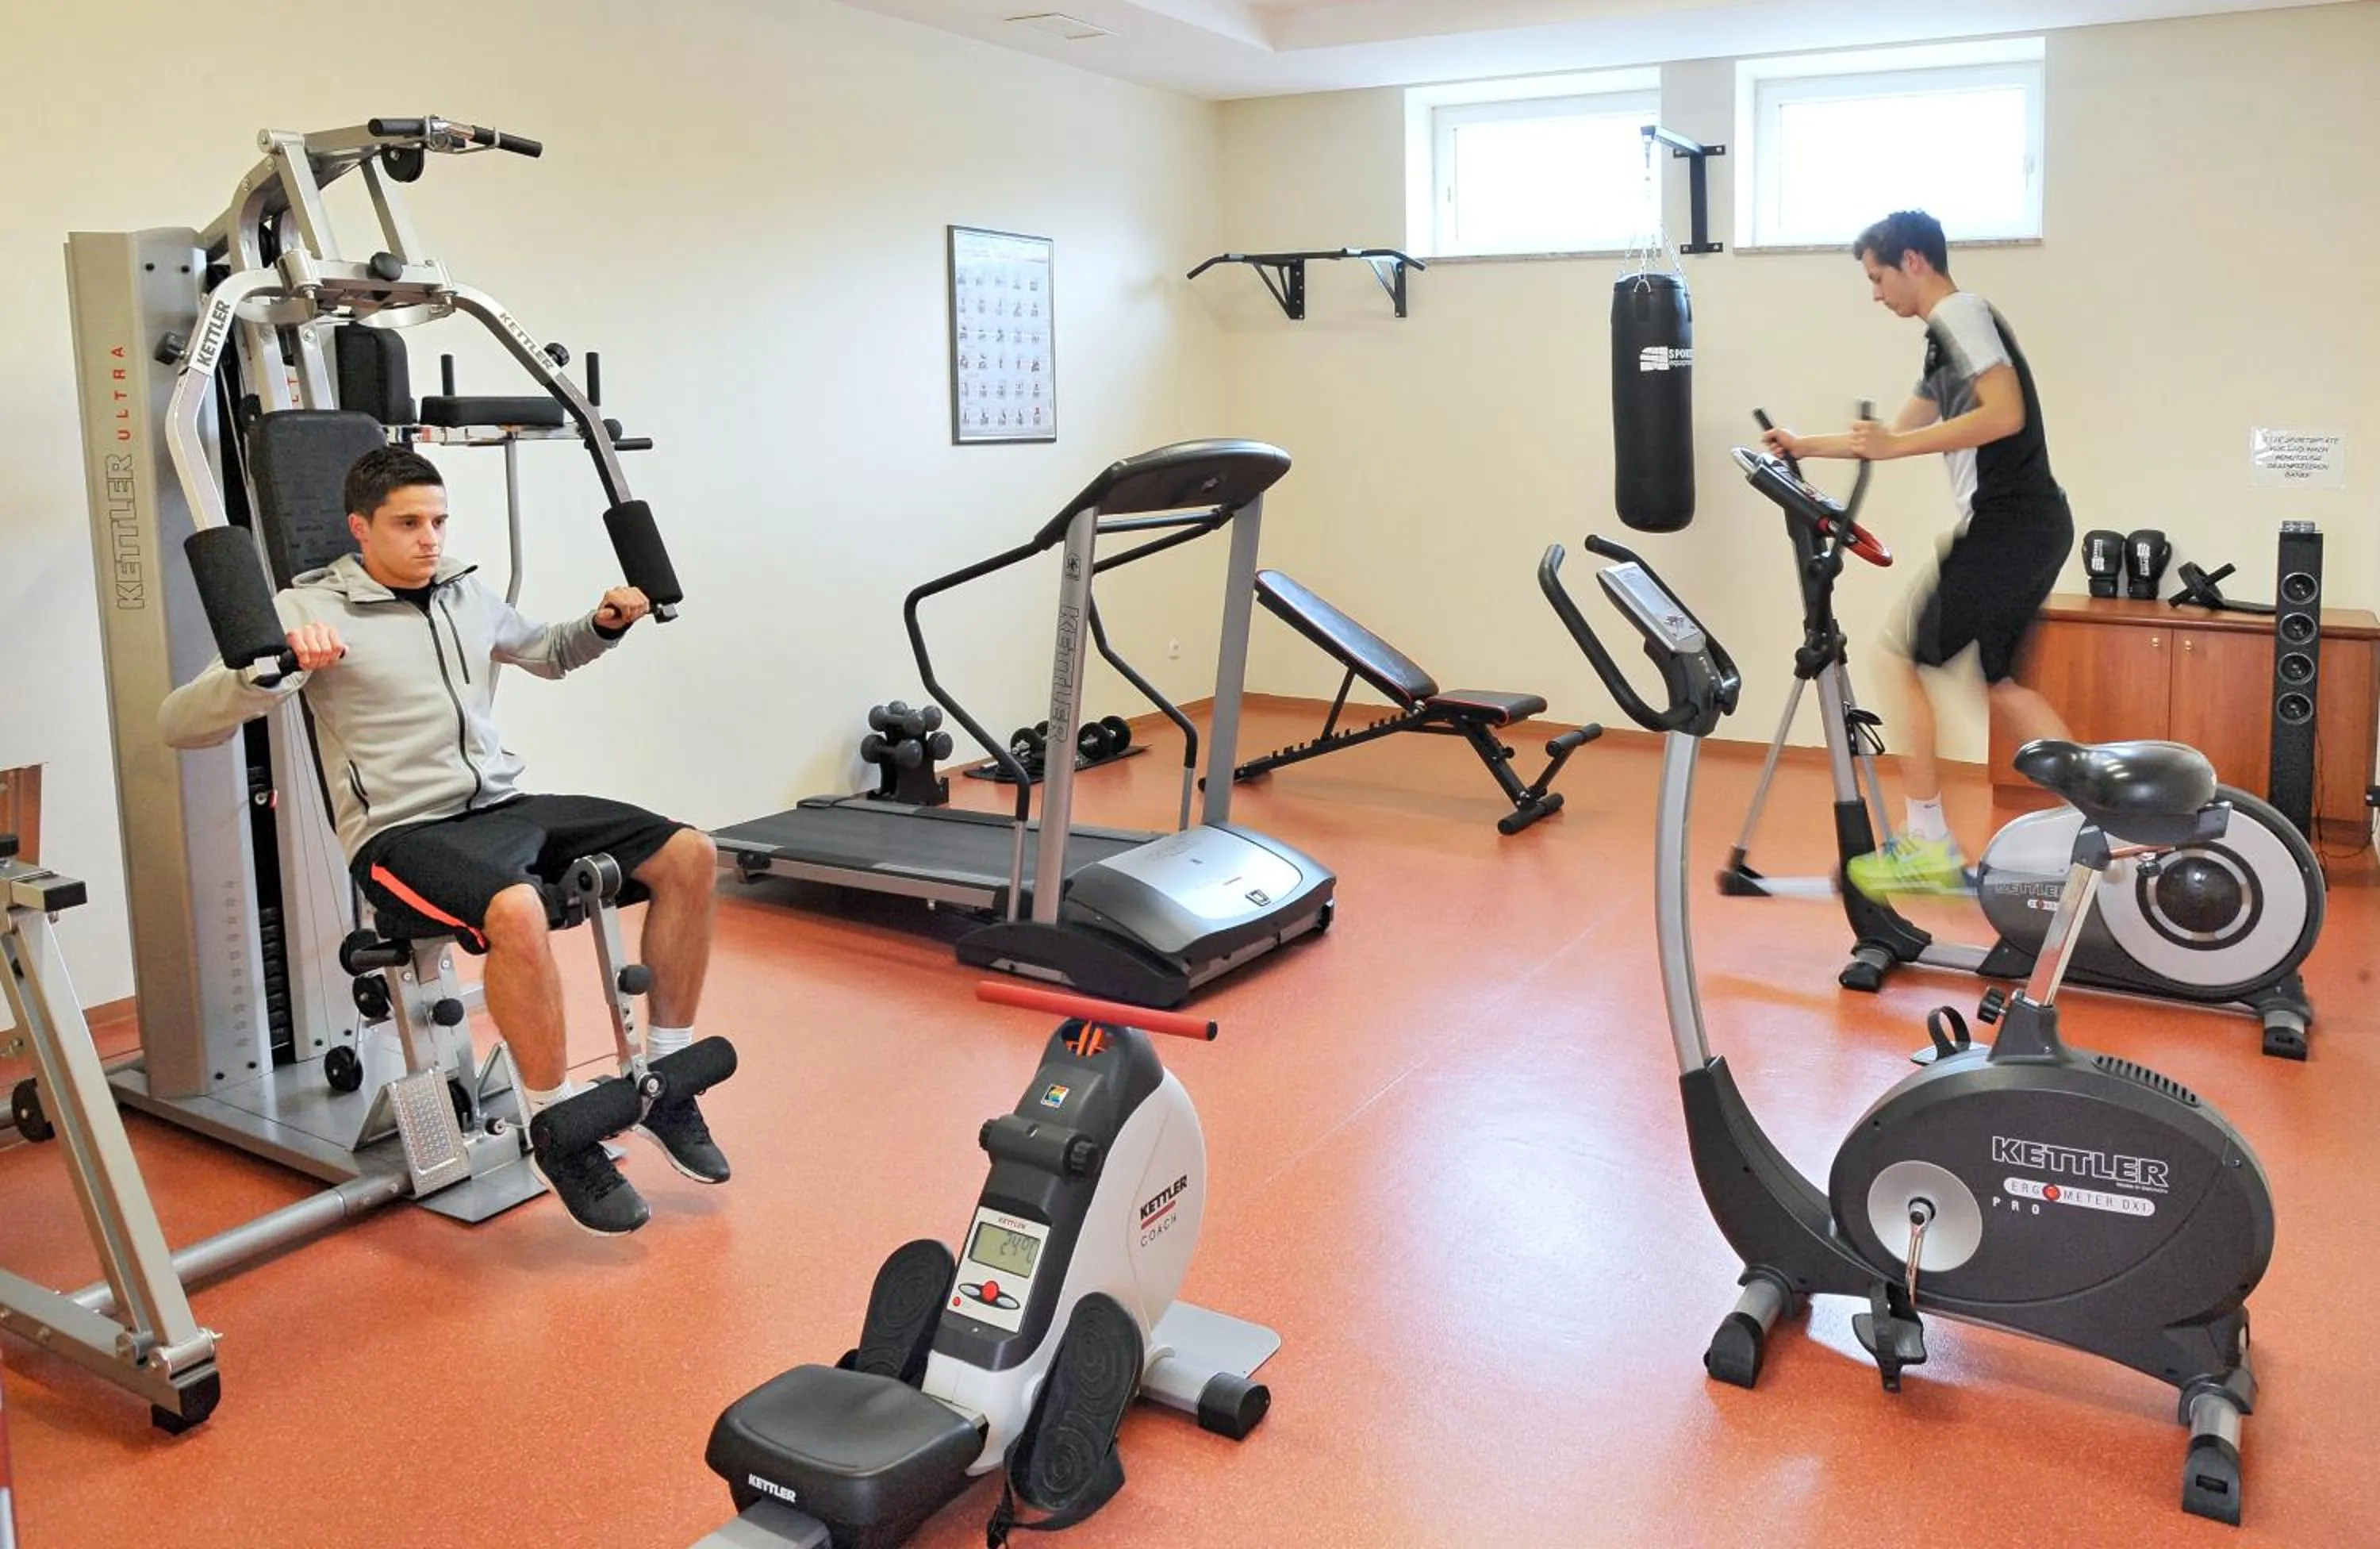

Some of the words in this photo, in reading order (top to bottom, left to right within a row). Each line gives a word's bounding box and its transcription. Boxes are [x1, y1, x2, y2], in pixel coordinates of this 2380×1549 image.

[196, 299, 230, 367] KETTLER
[499, 313, 554, 370] KETTLER
[111, 347, 131, 440] ULTRA
[106, 453, 144, 609] KETTLER
[1049, 605, 1080, 744] KETTLER
[1992, 1136, 2169, 1188] KETTLER
[1140, 1174, 1187, 1220] KETTLER
[1992, 1197, 2040, 1215] PRO
[1141, 1213, 1177, 1247] COACH
[748, 1473, 796, 1502] KETTLER
